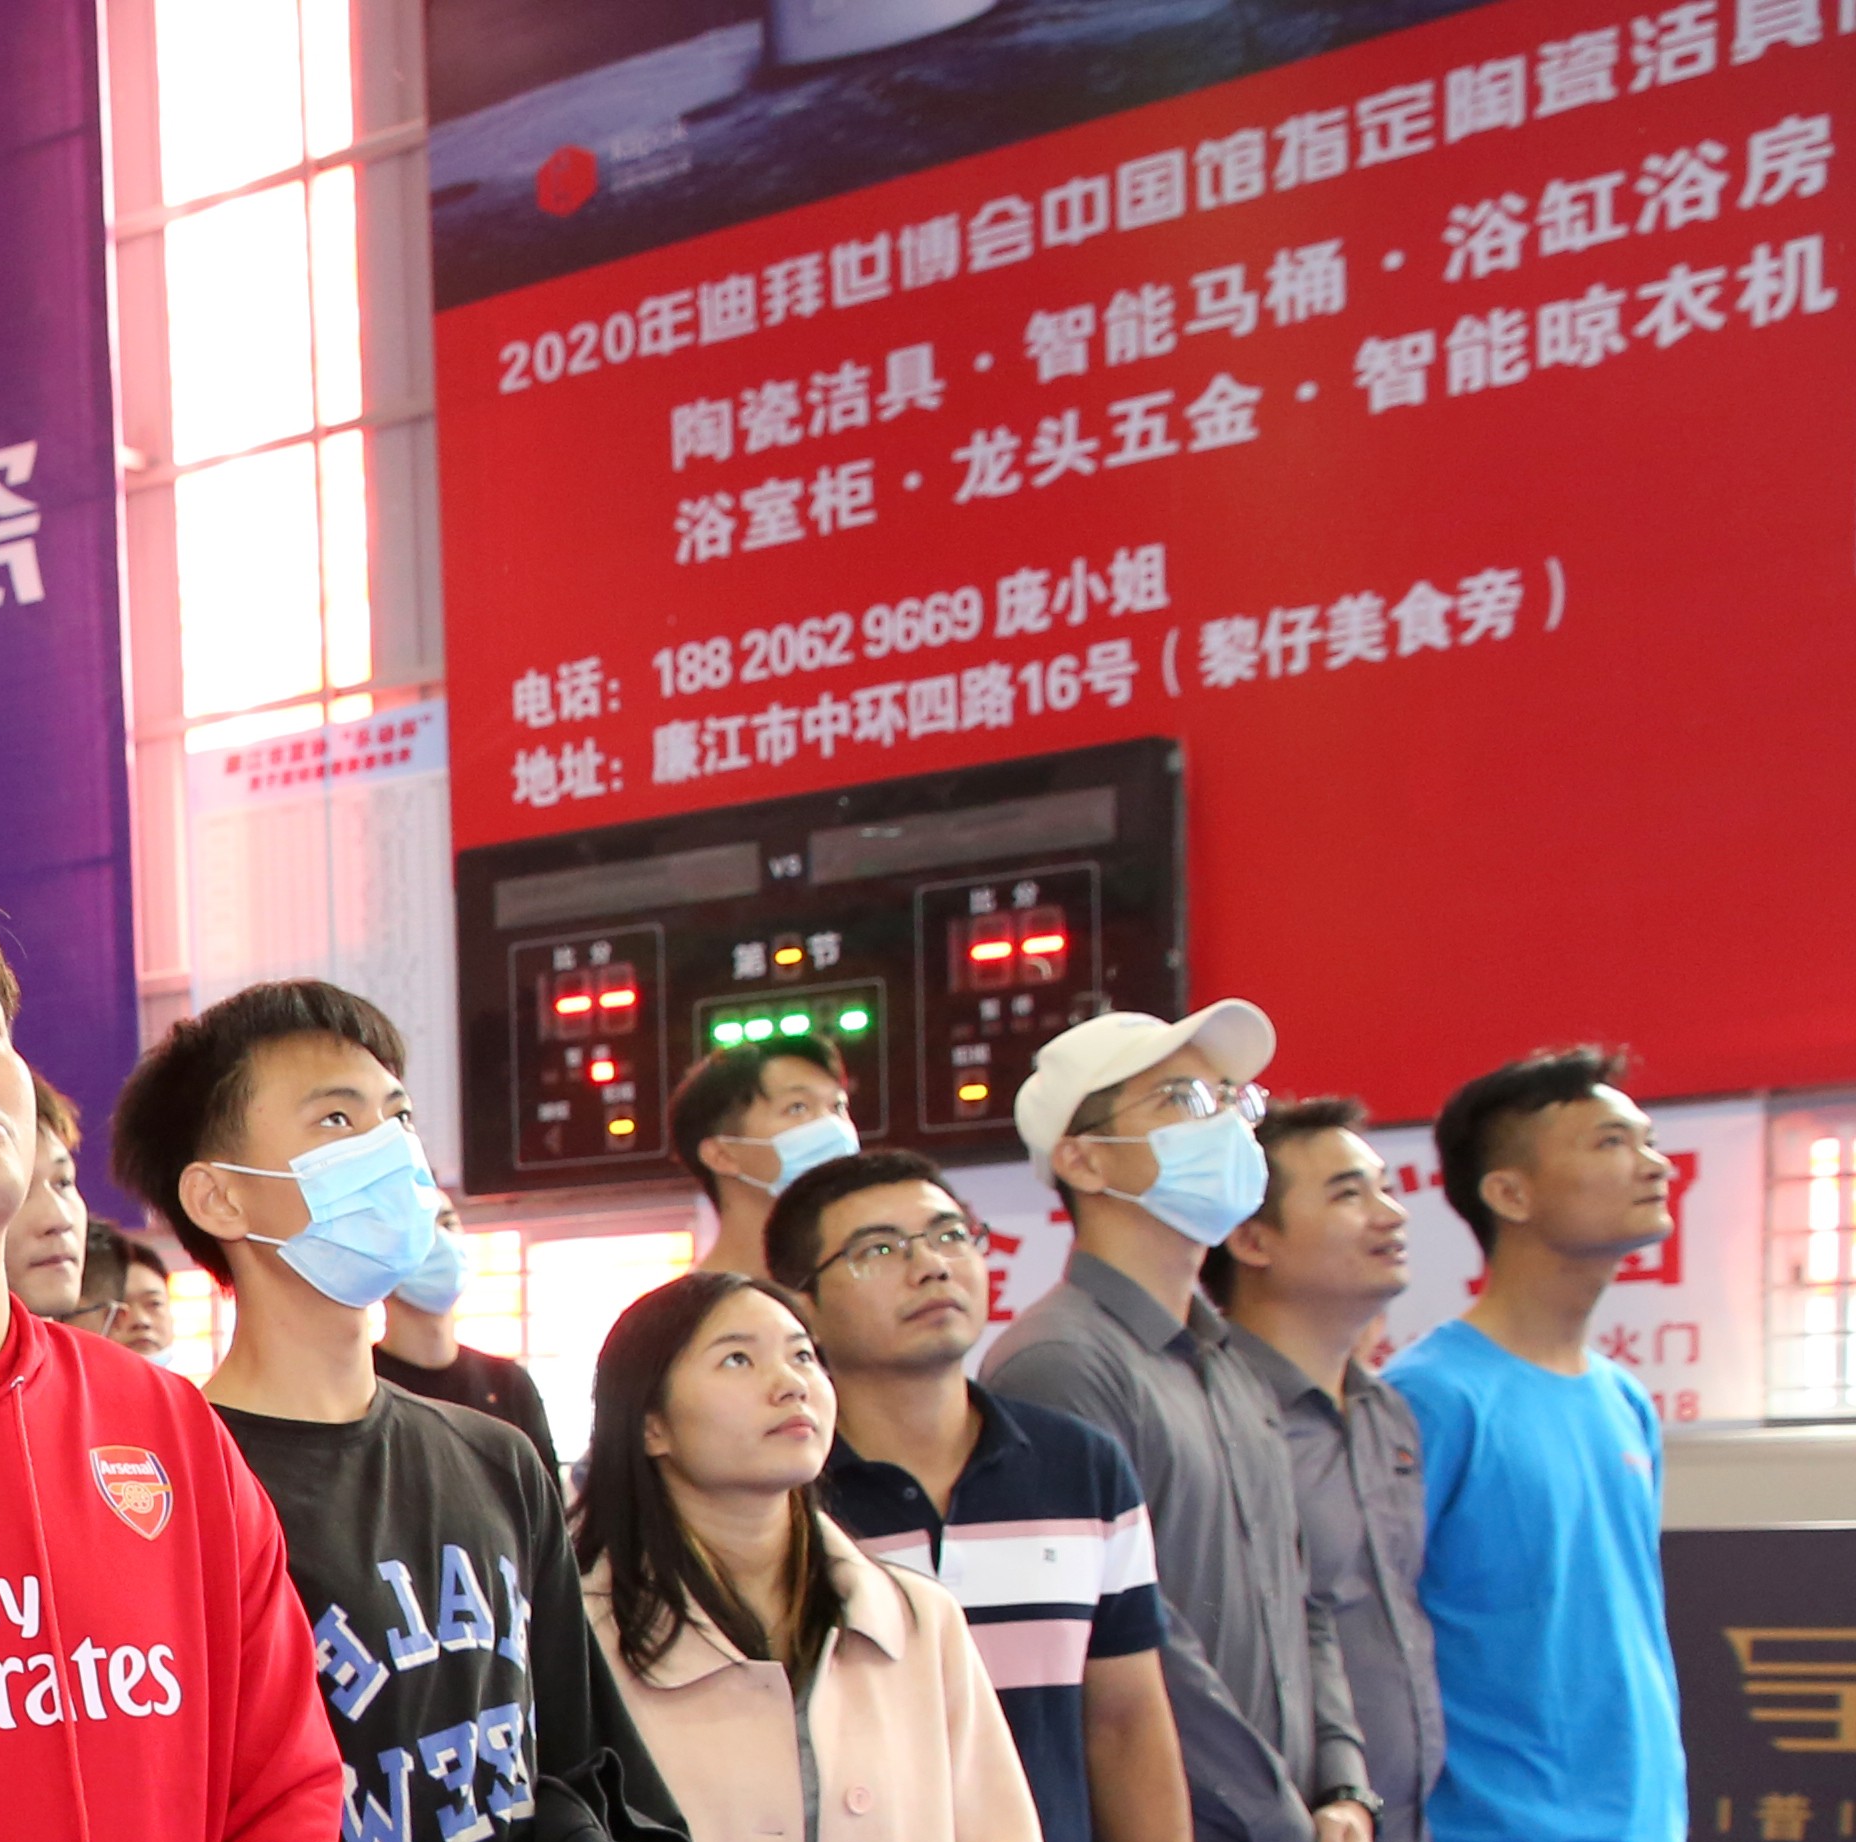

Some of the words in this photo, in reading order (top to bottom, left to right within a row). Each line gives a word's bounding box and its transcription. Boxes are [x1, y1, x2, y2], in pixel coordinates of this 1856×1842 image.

[653, 640, 733, 698] 188
[739, 618, 854, 683] 2062
[863, 589, 984, 658] 9669
[100, 1460, 156, 1475] Arsenal
